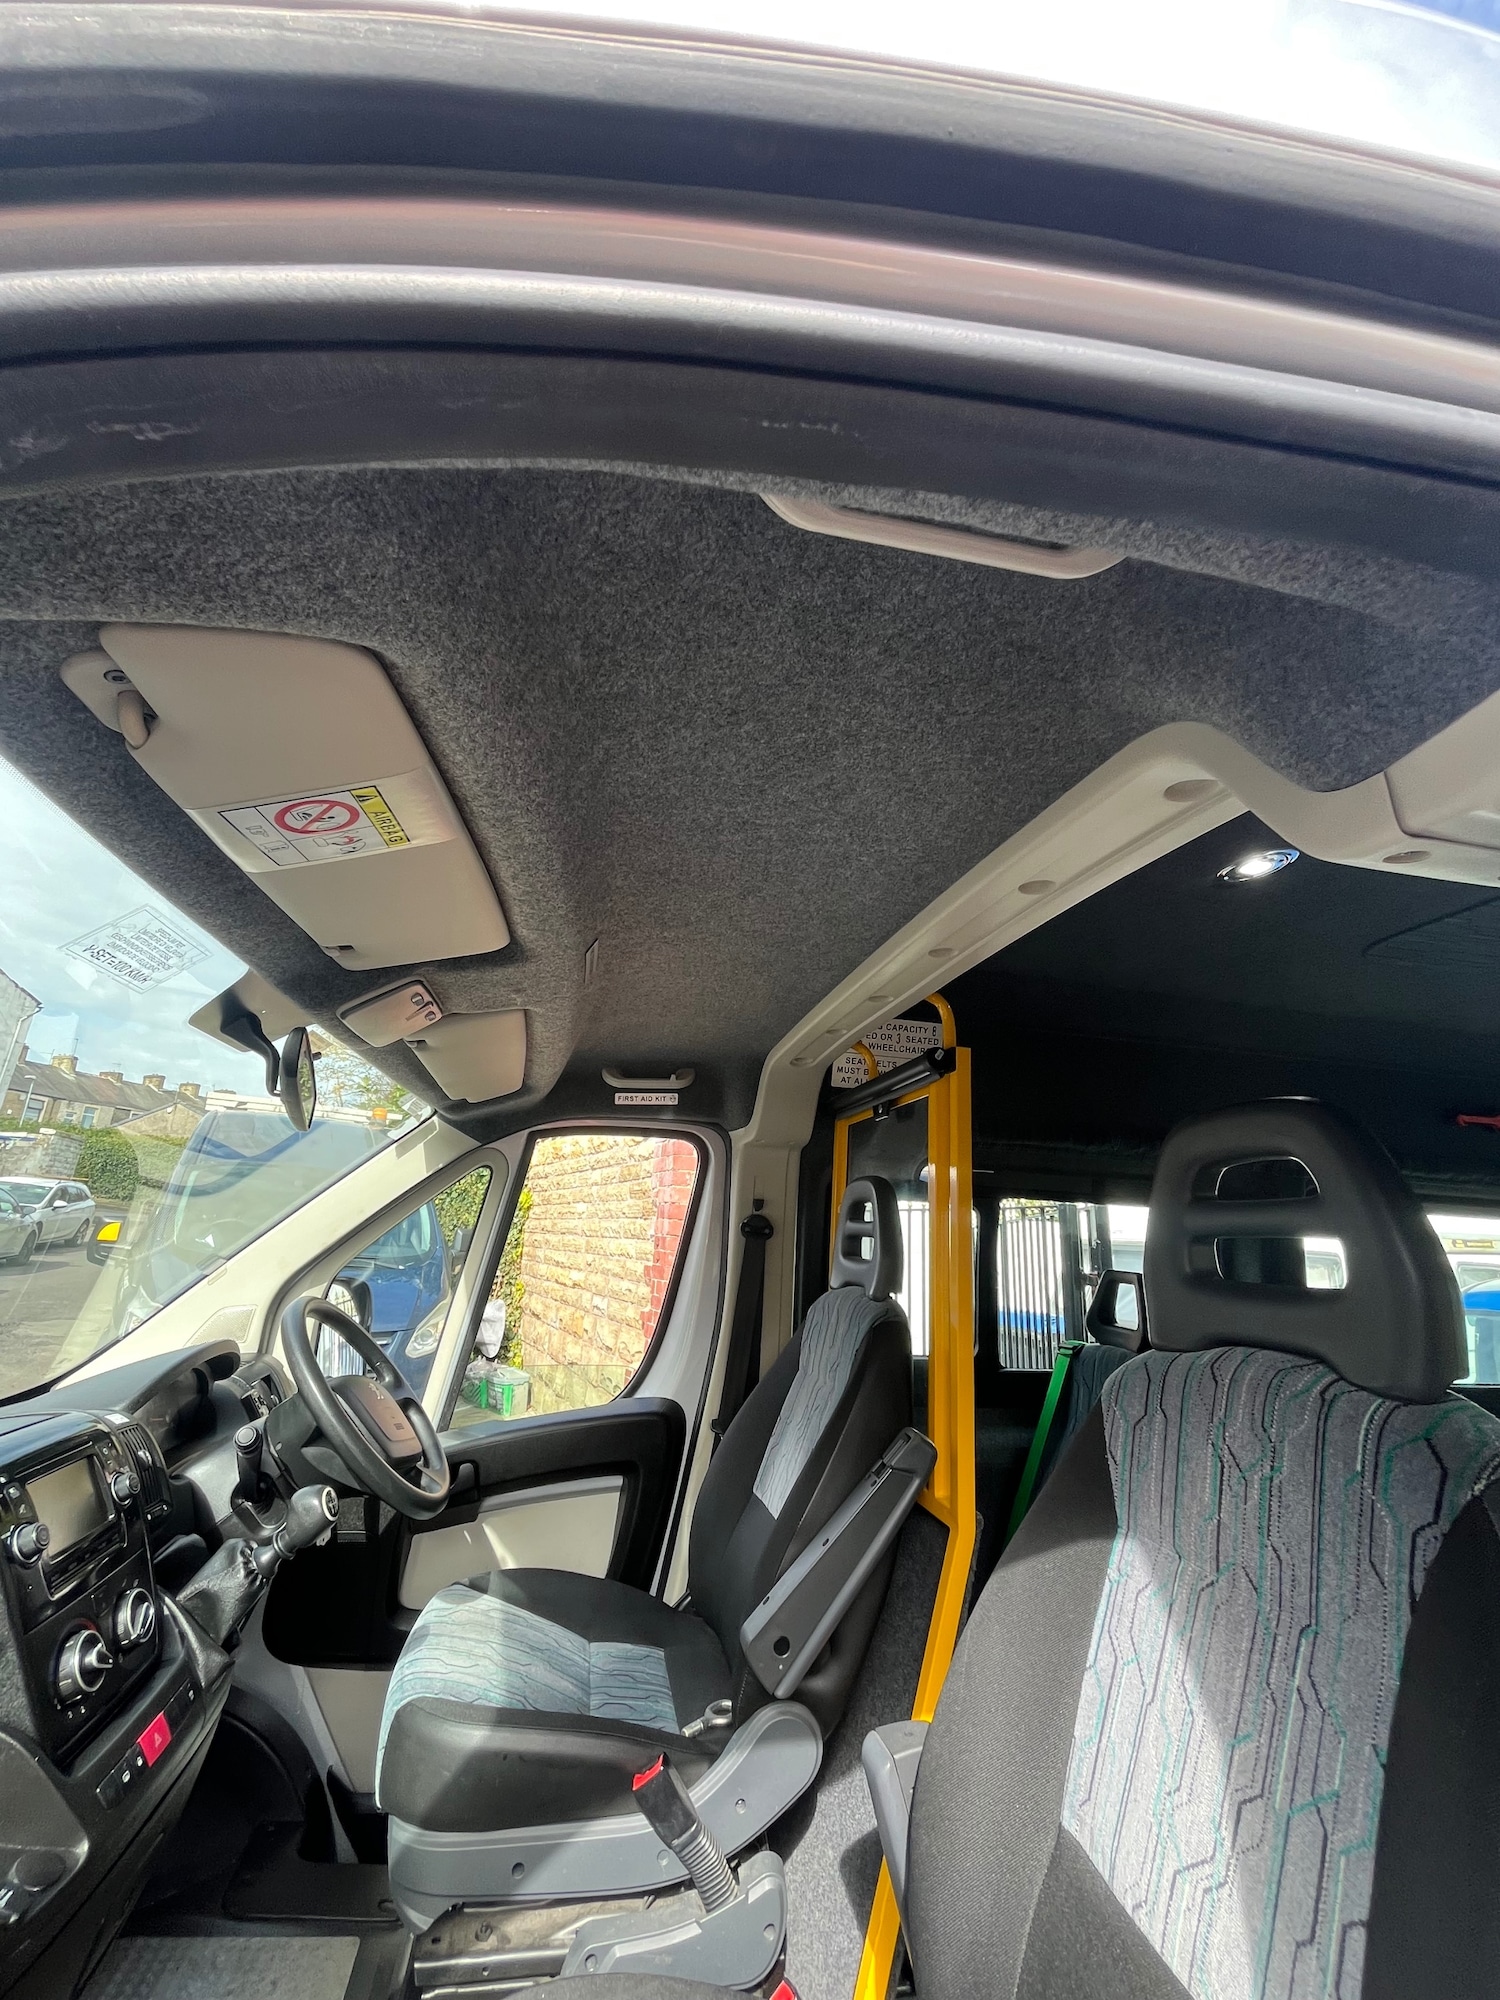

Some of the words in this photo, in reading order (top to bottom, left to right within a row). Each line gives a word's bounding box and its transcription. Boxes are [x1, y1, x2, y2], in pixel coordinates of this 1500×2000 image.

[369, 810, 404, 843] AIRBAG
[886, 1023, 929, 1034] CAPACITY
[932, 1025, 937, 1037] 8
[880, 1033, 893, 1041] OR
[896, 1033, 901, 1044] 3
[906, 1035, 939, 1045] SEATED
[836, 1066, 861, 1075] MUST
